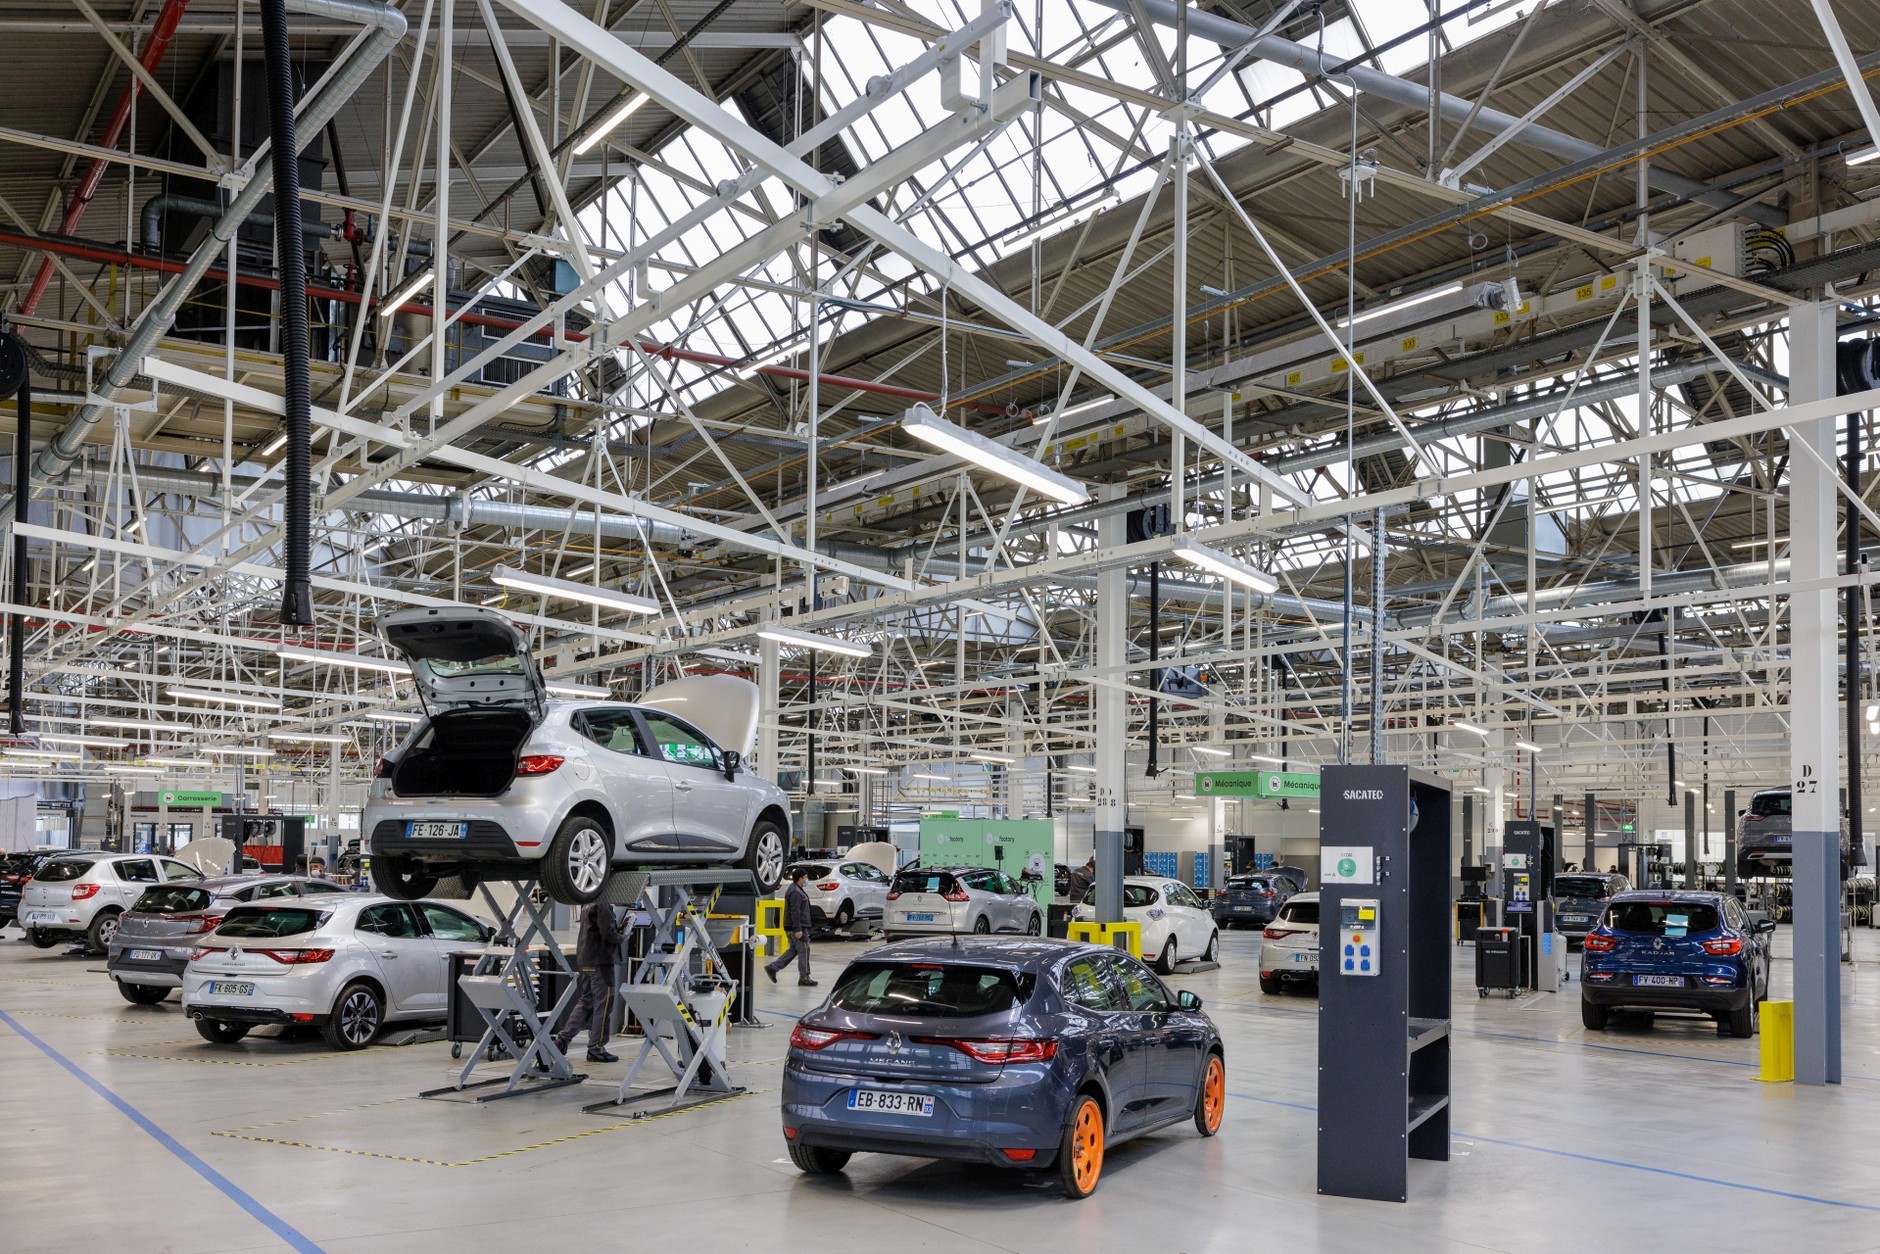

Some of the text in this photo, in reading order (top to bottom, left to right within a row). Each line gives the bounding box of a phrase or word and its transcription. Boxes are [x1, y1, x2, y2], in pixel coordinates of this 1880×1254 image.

[1577, 288, 1592, 298] 135
[1495, 312, 1509, 322] 133
[1802, 765, 1812, 777] D
[1215, 780, 1252, 789] Mécanique
[1796, 780, 1818, 793] 27
[1343, 789, 1383, 800] SACATEC
[412, 824, 460, 836] FE-126-JA
[999, 835, 1015, 843] factory
[857, 1091, 924, 1112] EB-833-RN
